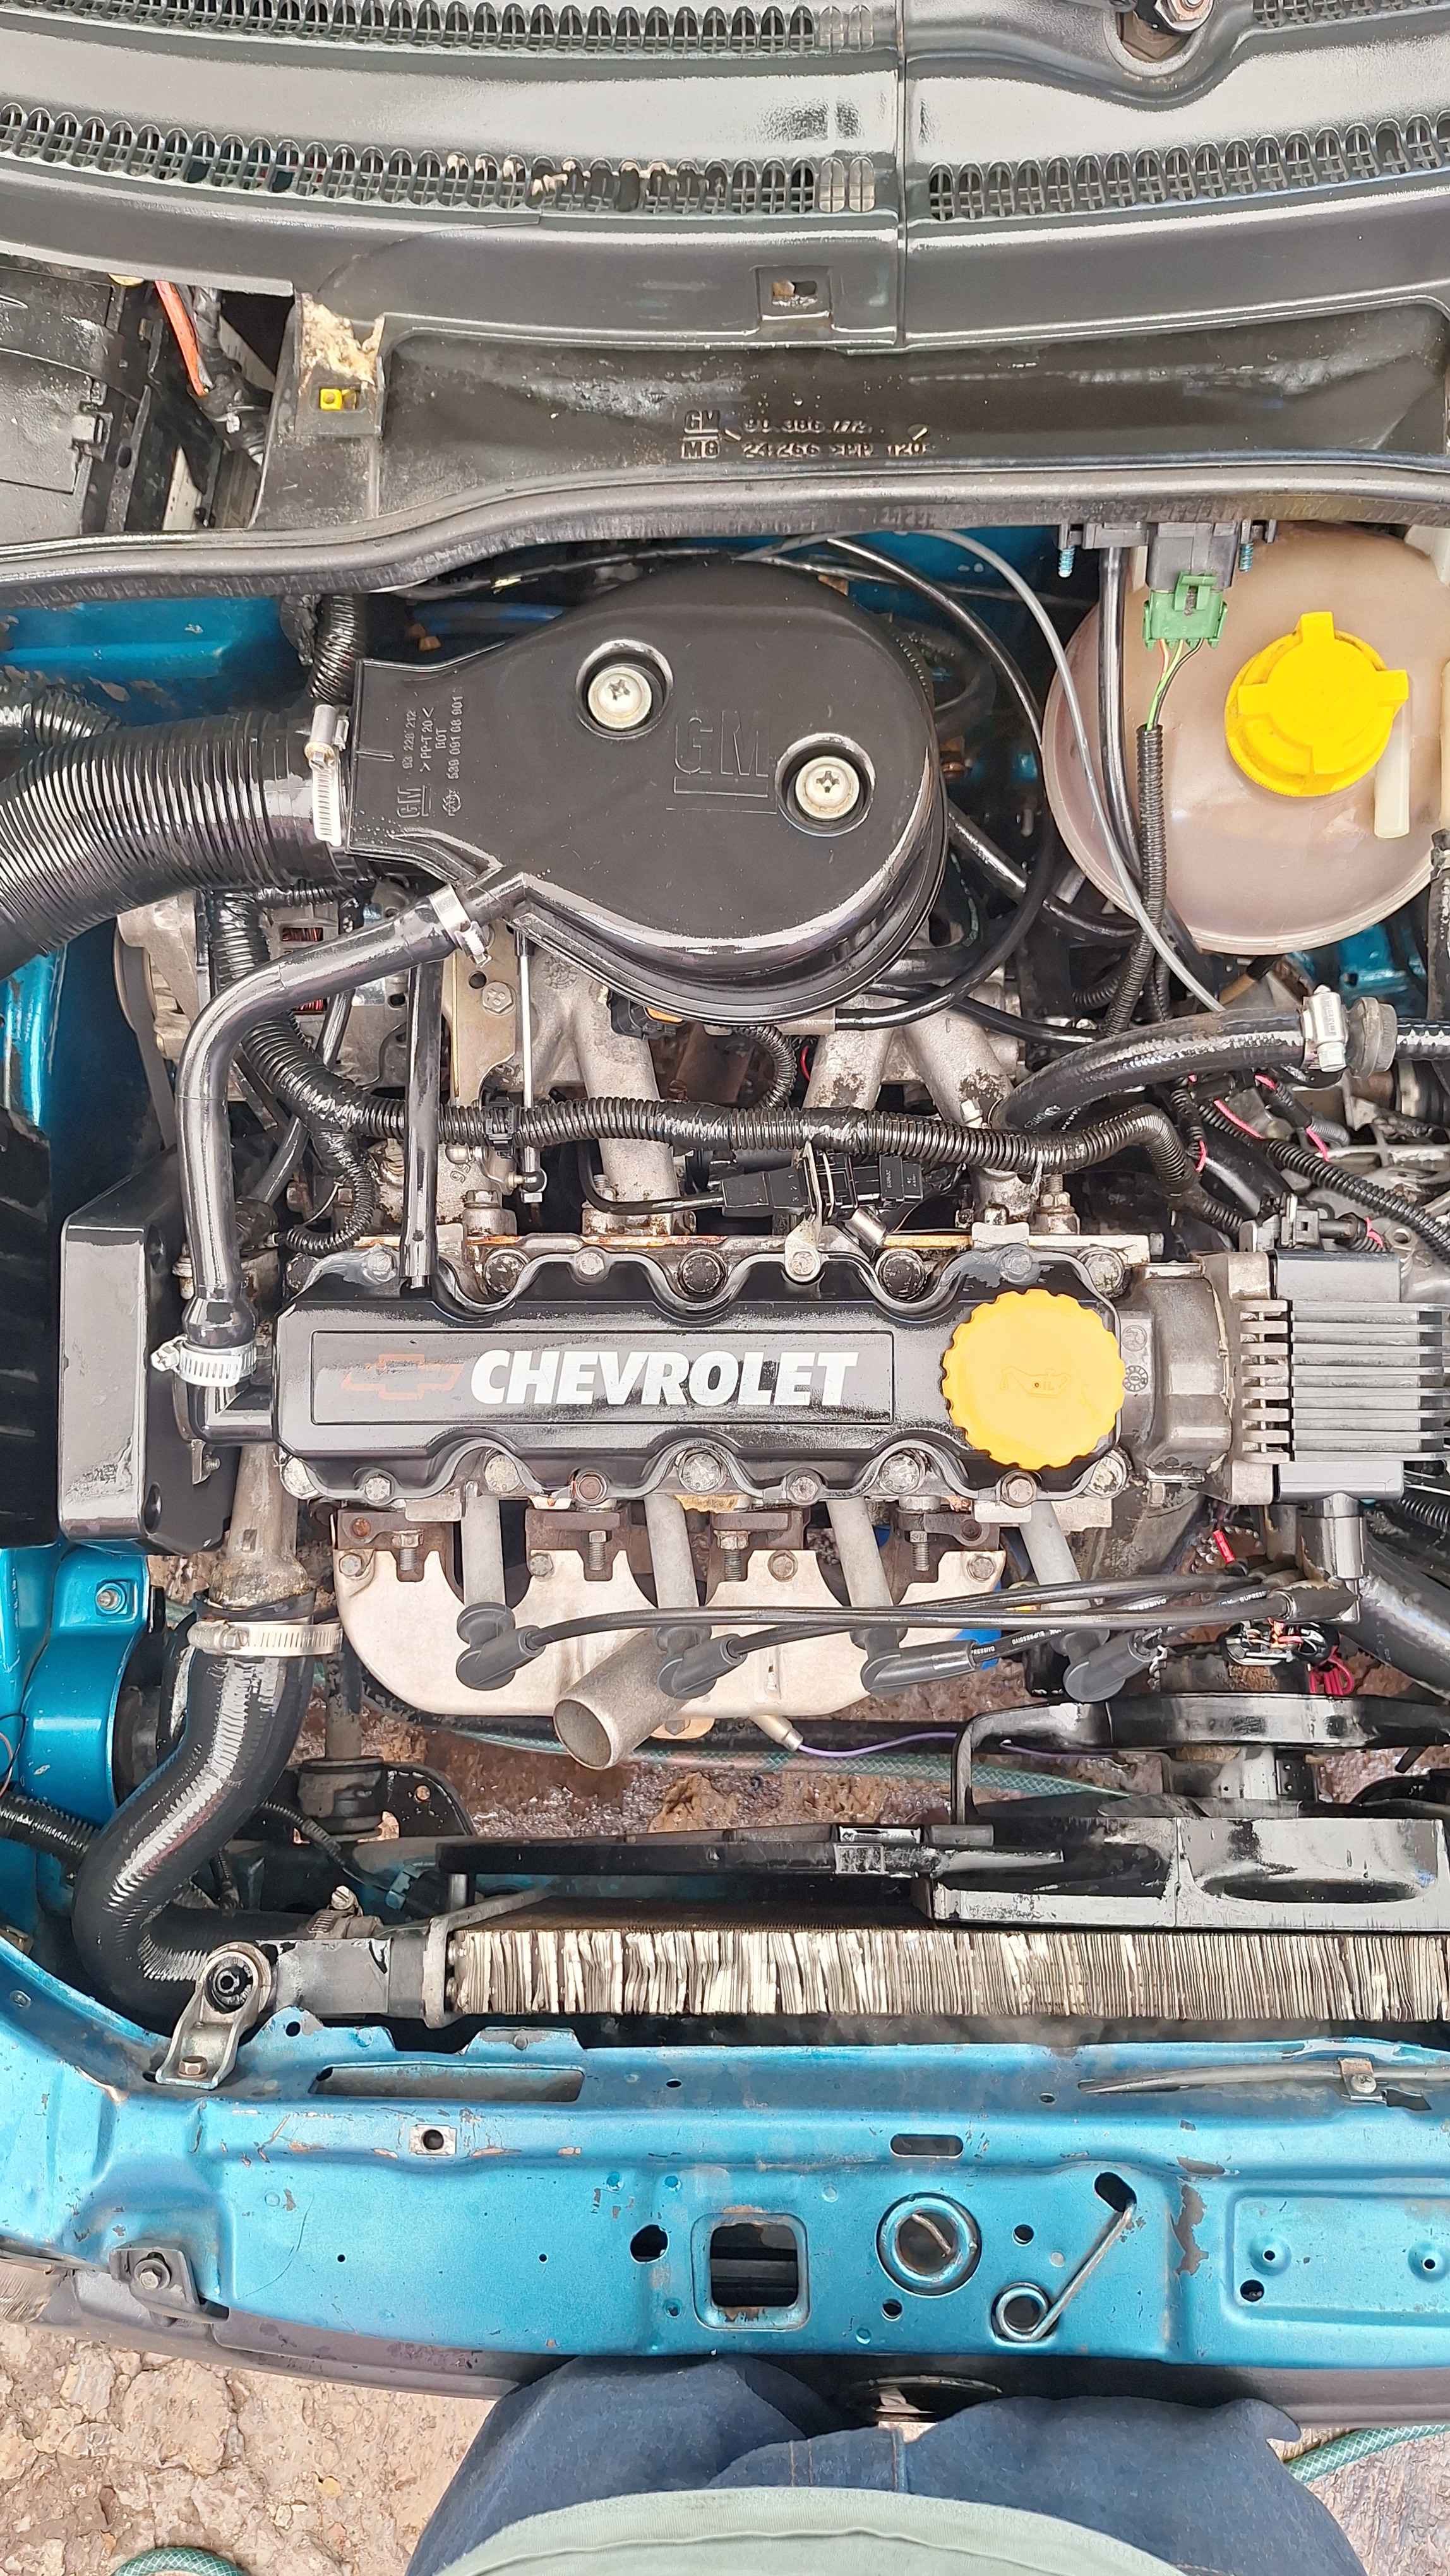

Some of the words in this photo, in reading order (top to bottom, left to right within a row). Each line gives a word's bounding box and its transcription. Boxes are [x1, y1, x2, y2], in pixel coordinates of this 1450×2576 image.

[684, 410, 720, 433] GM
[675, 711, 769, 777] GM
[397, 786, 421, 818] GM
[470, 1349, 860, 1407] CHEVROLET
